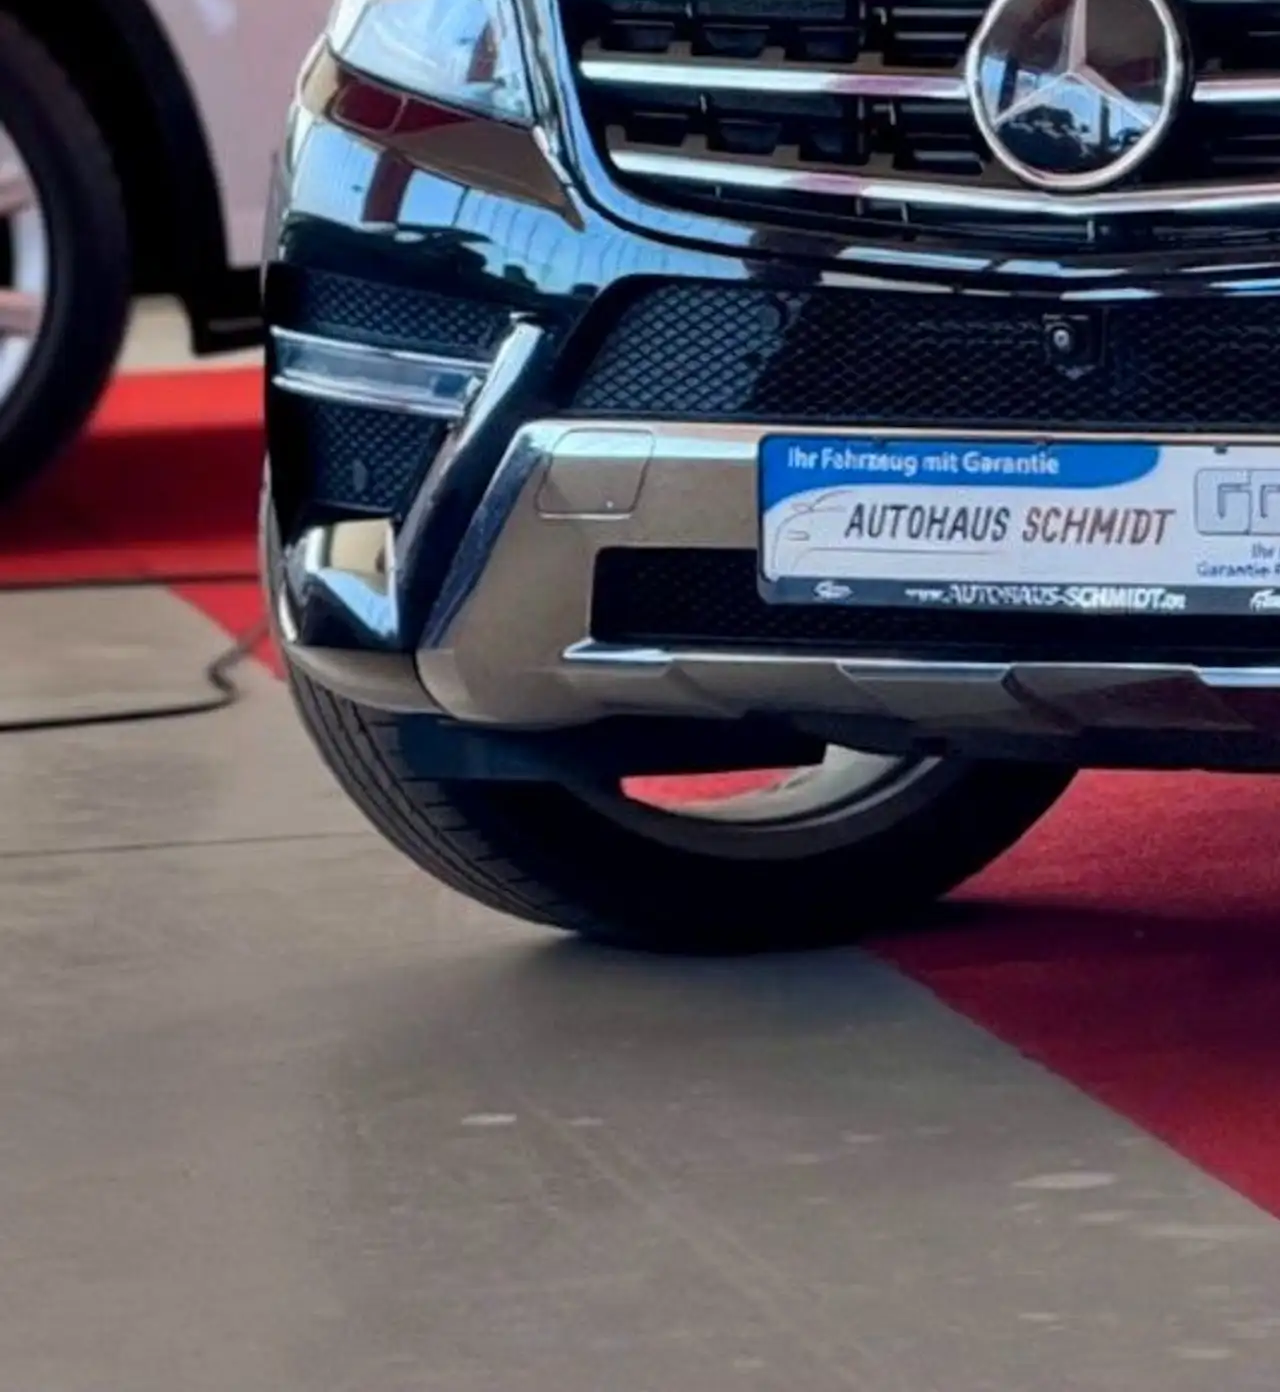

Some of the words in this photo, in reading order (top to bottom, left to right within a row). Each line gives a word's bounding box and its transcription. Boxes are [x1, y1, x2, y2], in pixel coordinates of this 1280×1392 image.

[788, 447, 818, 468] Ihr
[821, 448, 918, 476] Fahrzeug
[923, 452, 959, 473] mit
[962, 451, 1060, 475] Garantie
[845, 503, 1010, 542] AUTOHAUS
[1022, 506, 1176, 545] SCHMIDT
